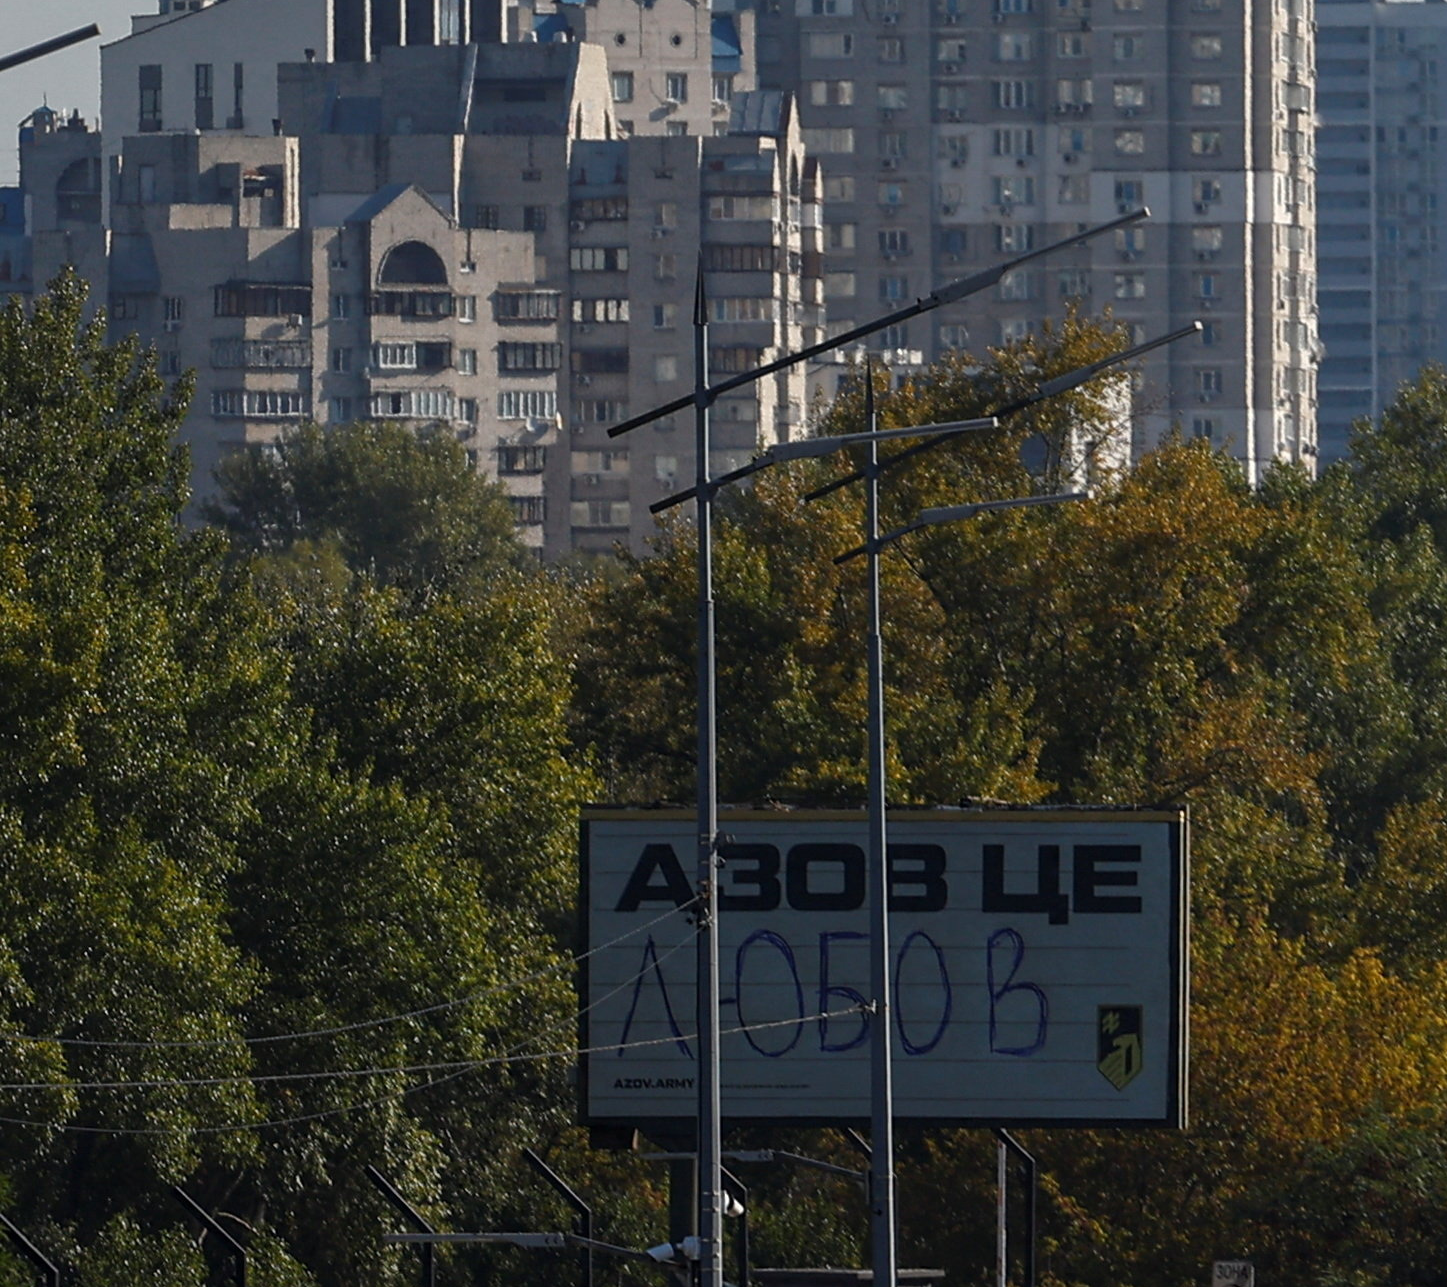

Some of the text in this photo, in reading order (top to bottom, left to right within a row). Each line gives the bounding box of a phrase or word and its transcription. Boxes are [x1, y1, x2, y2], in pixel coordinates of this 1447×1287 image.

[614, 843, 1143, 926] АЗОВ ЦЕ
[614, 1078, 695, 1089] AZOV.ARMY
[1216, 1263, 1249, 1280] ЗОНА
